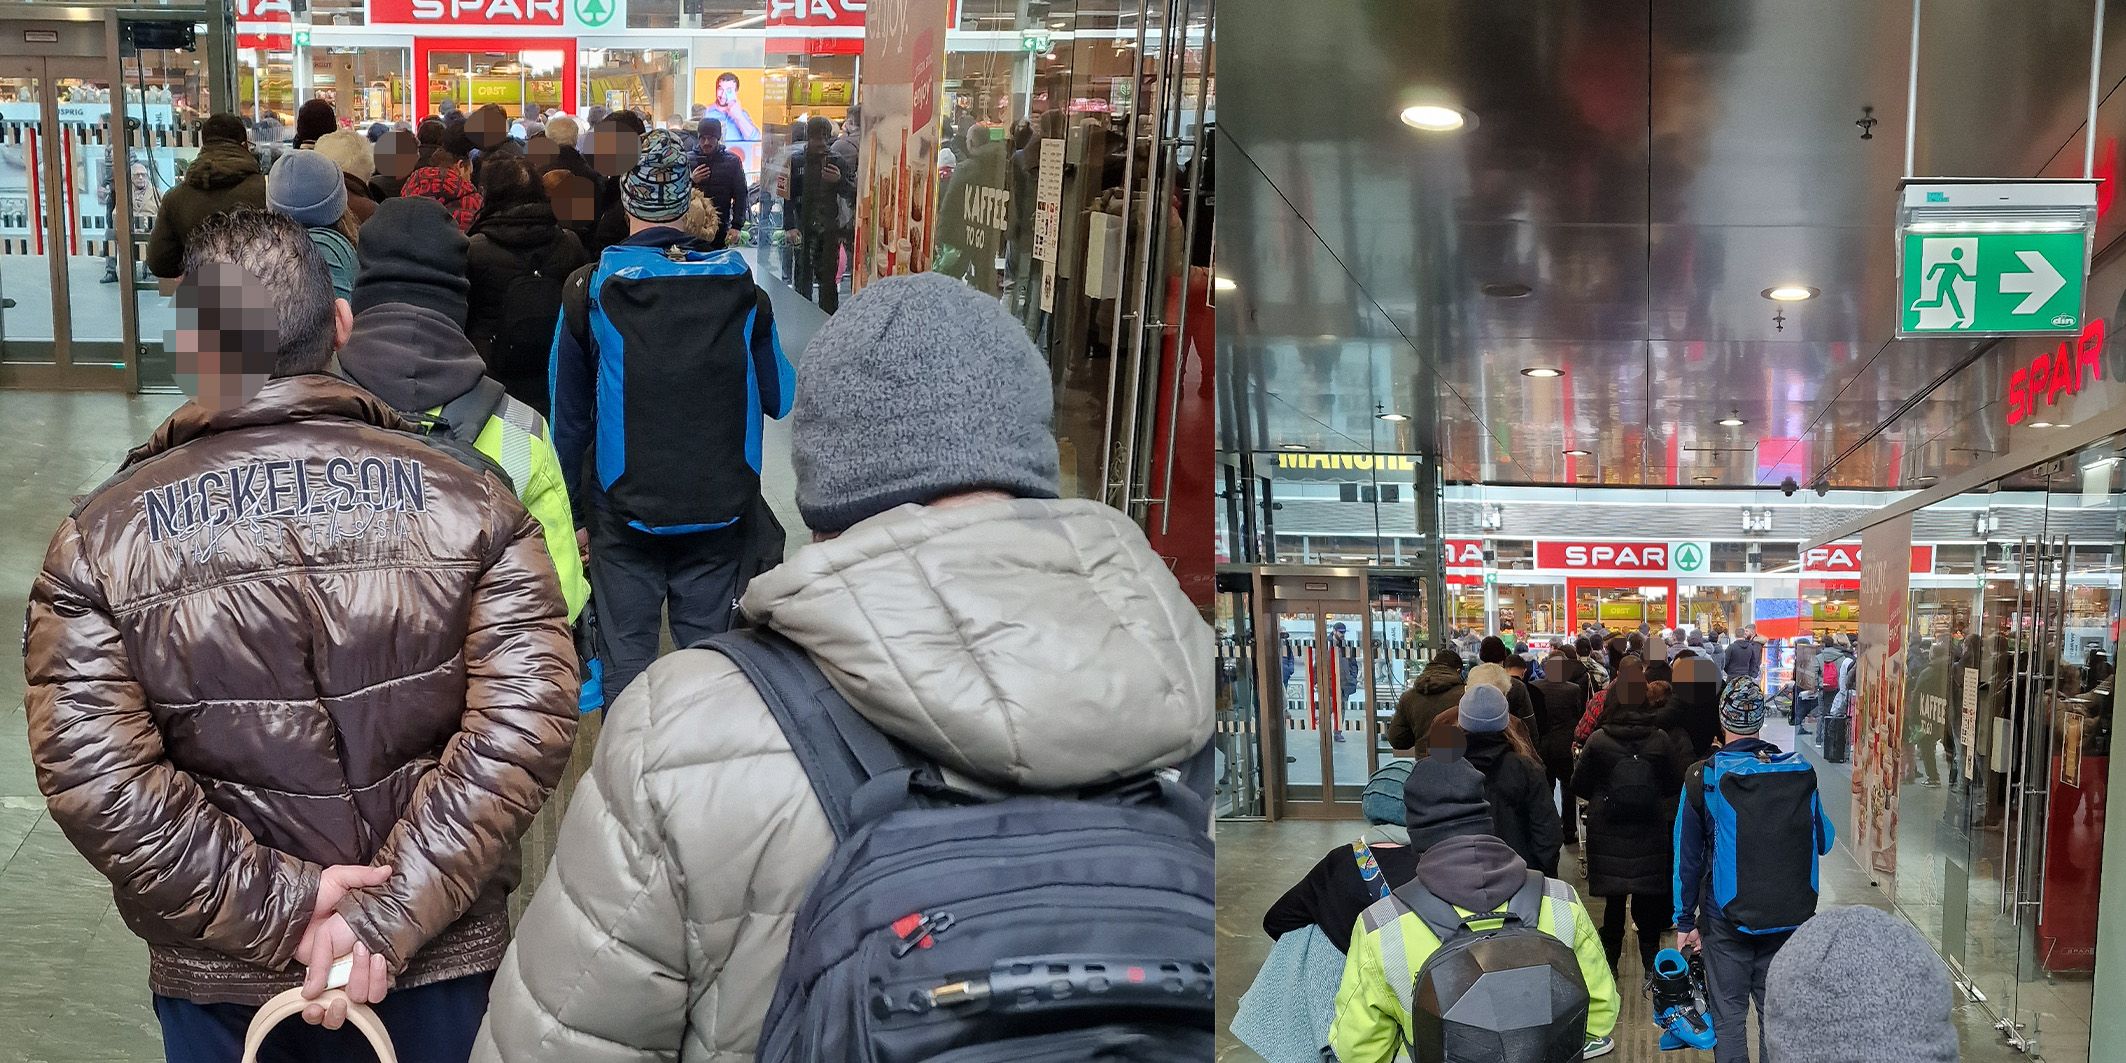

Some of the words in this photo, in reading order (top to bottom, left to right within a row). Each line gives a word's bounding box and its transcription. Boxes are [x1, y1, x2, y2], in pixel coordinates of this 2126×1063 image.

[412, 0, 560, 20] SPAR
[478, 86, 507, 96] OBST
[963, 183, 1010, 231] KAFFEE
[966, 225, 975, 246] TO
[975, 228, 985, 249] GO
[2006, 317, 2104, 425] SPAR
[144, 456, 428, 543] NICKELSON
[1565, 546, 1665, 567] SPAR
[1919, 692, 1947, 725] KAFFEE
